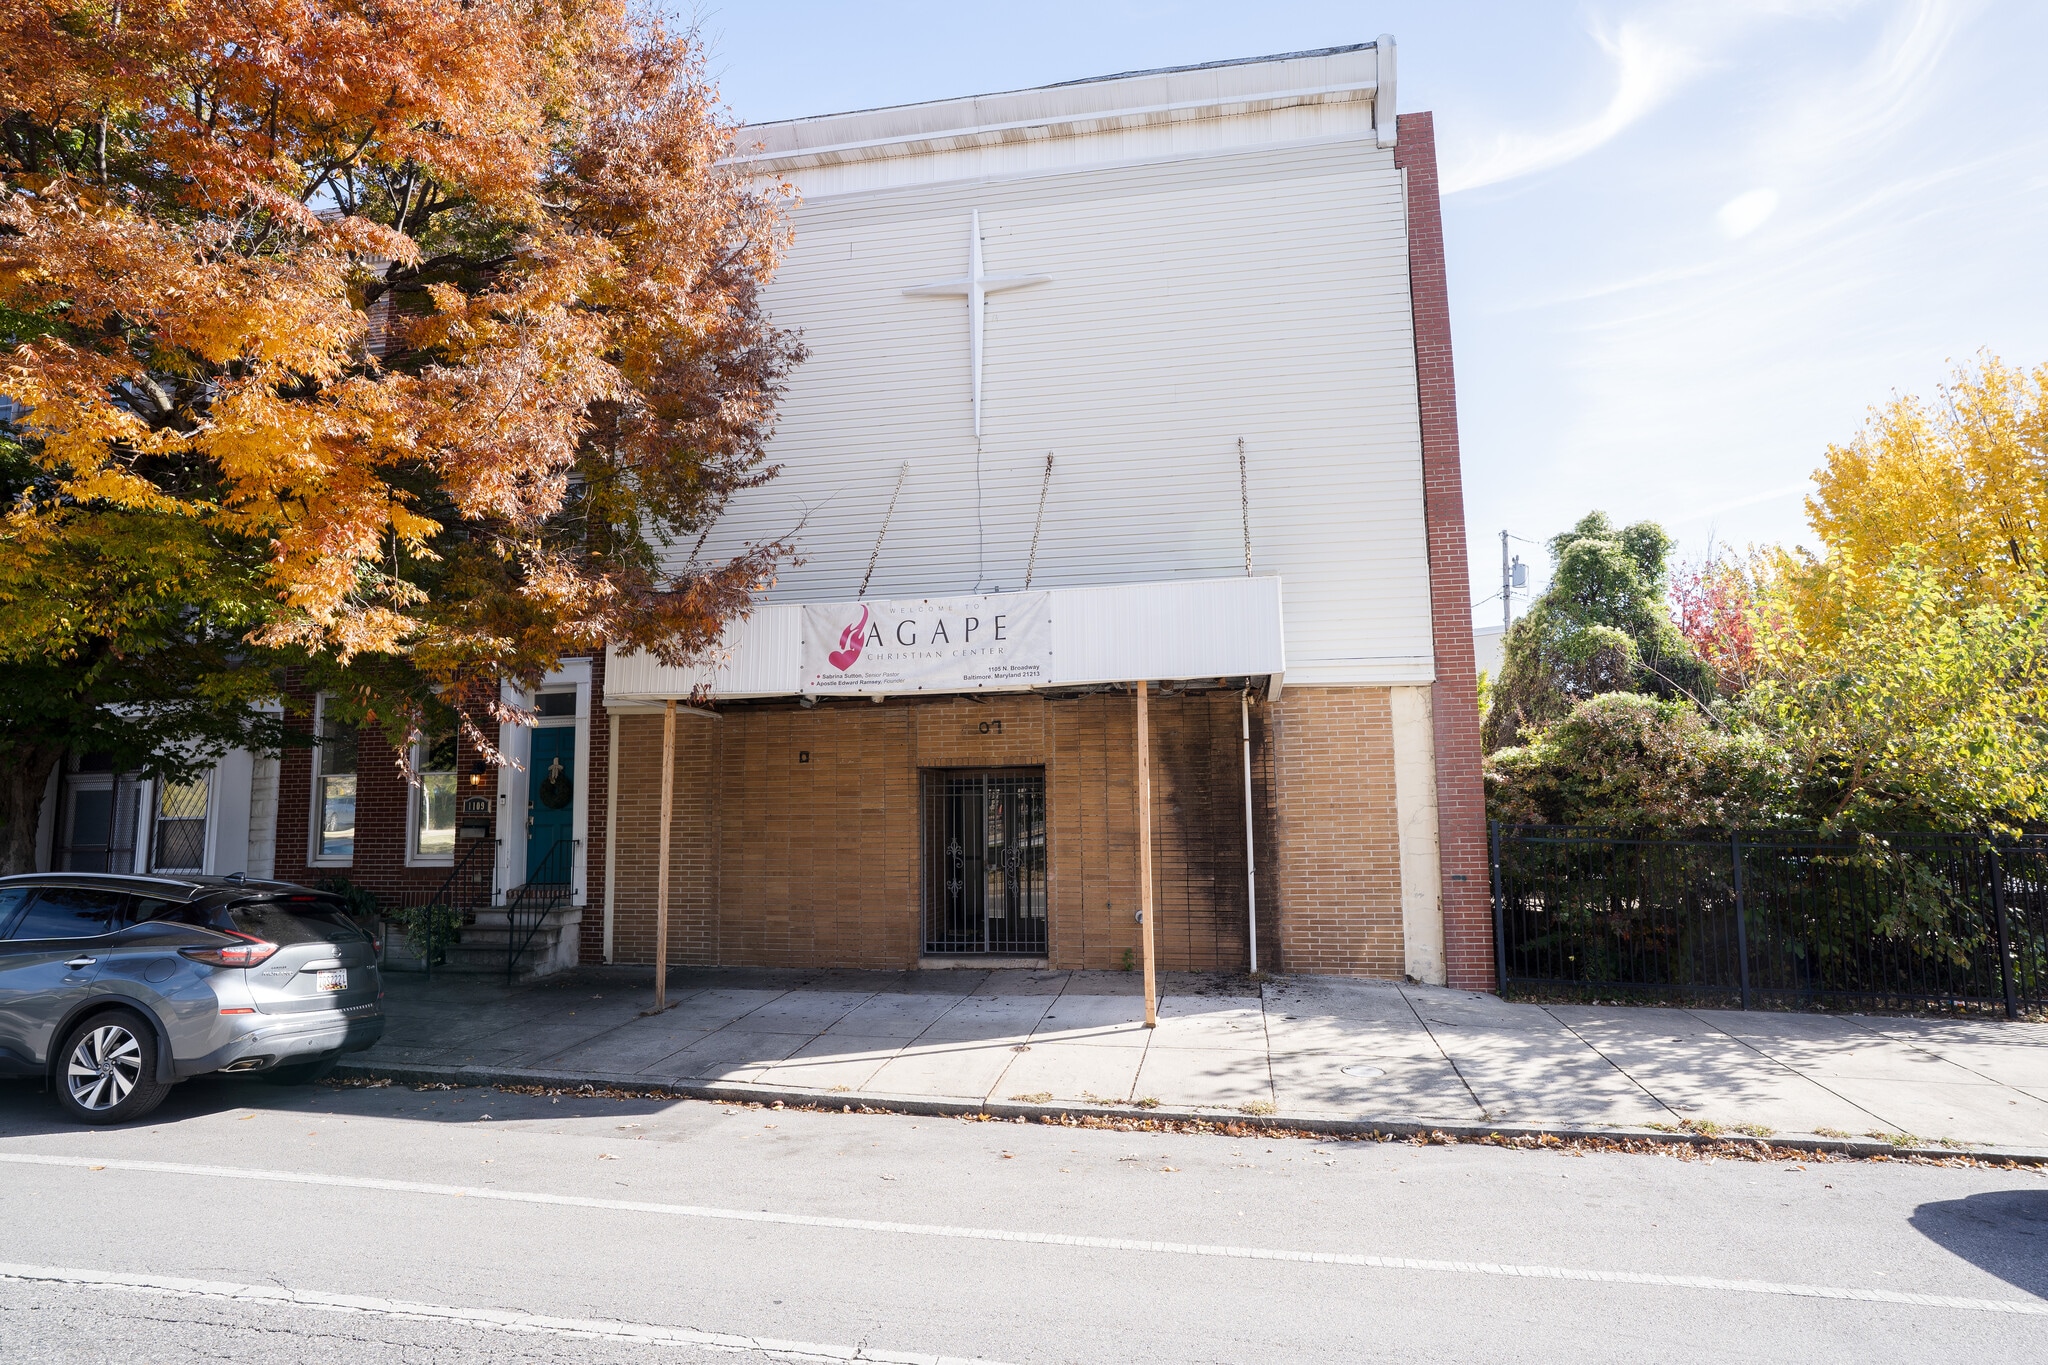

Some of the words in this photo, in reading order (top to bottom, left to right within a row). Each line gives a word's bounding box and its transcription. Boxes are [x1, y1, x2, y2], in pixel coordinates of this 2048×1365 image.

[889, 605, 953, 614] WELCOME
[865, 615, 1007, 647] AGAPE
[867, 651, 943, 661] CHRISTIAN
[952, 647, 1005, 657] CENTER
[979, 720, 1002, 735] 07
[468, 801, 485, 811] 1109
